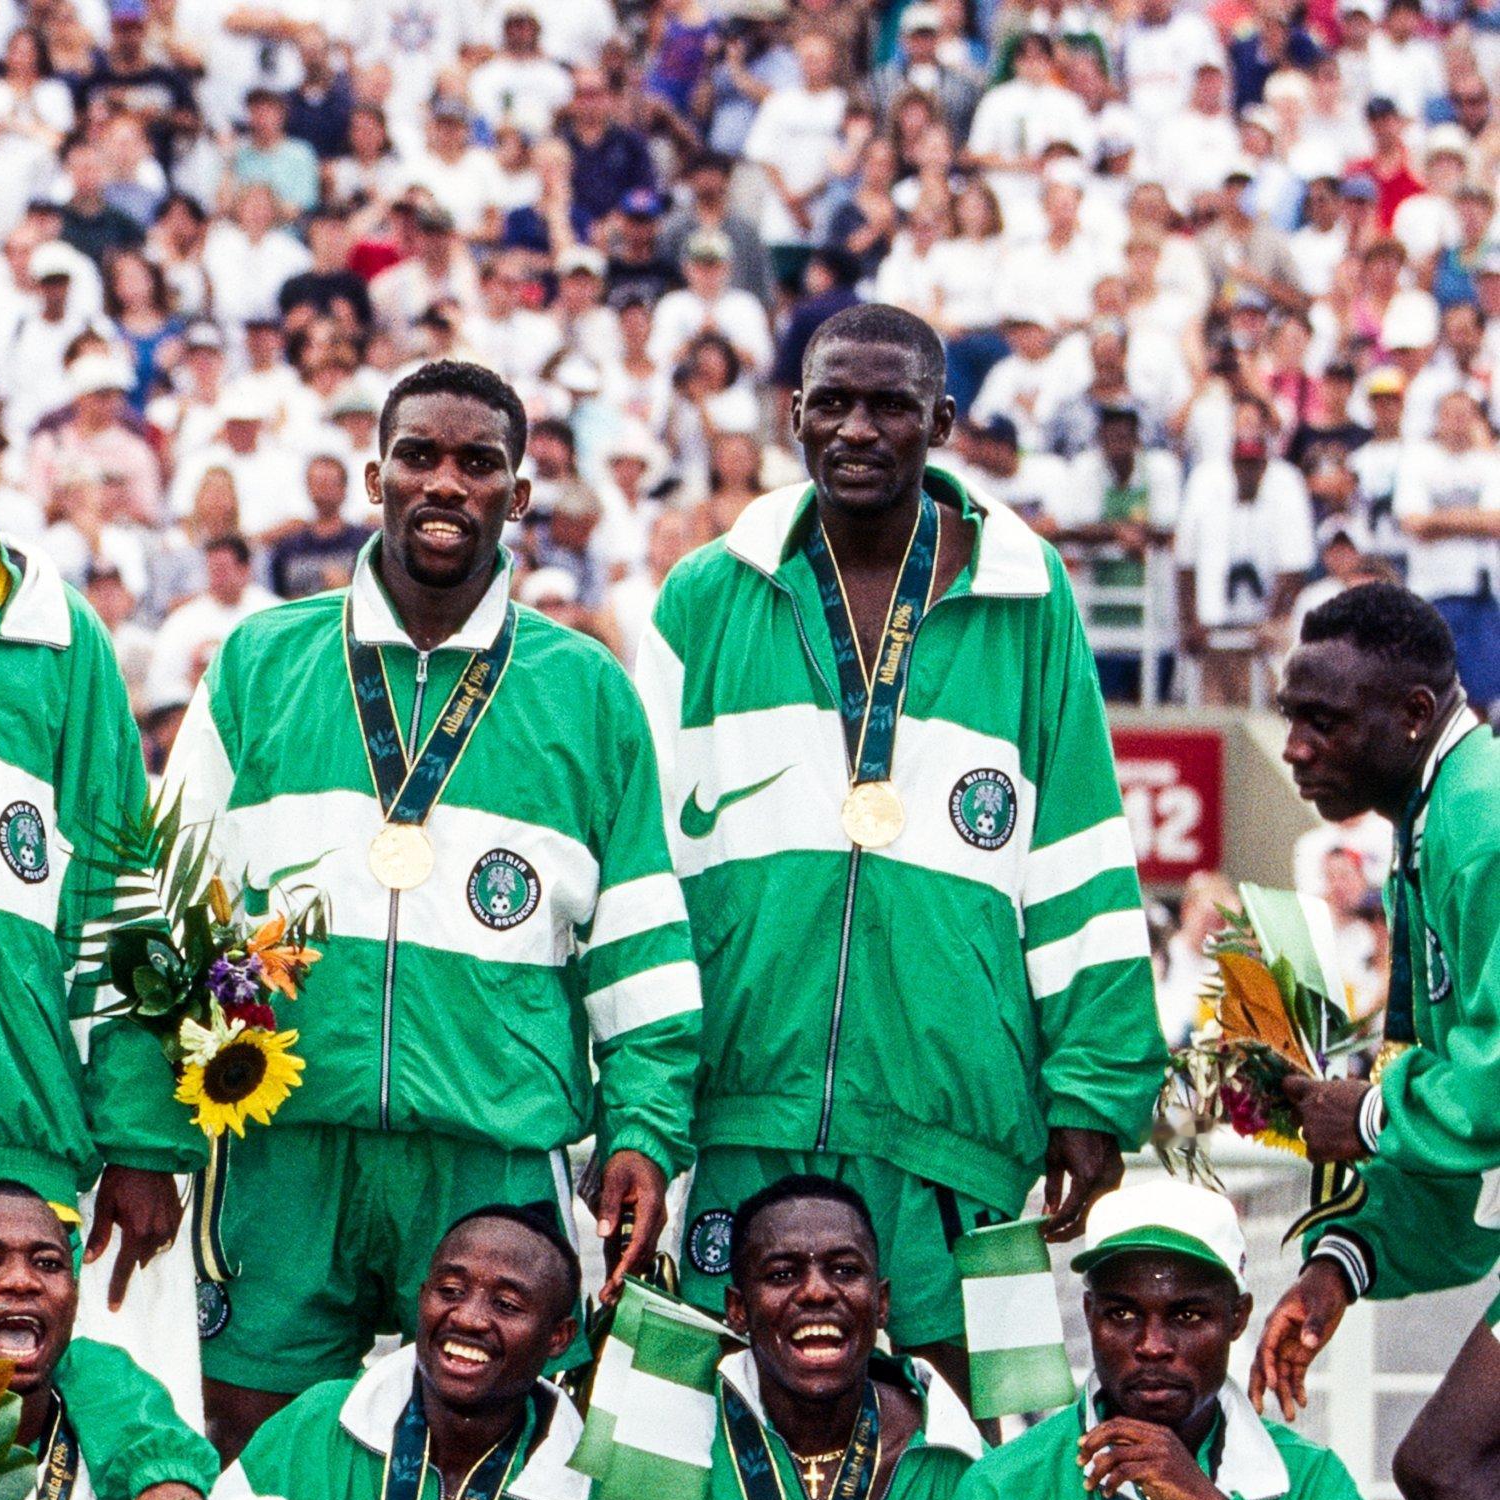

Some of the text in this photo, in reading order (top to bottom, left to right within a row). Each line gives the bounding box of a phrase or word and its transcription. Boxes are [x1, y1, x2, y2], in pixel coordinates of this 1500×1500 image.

[878, 604, 913, 685] Atlanta 1996
[441, 662, 491, 737] Atlanta 1996
[964, 770, 1013, 794] NIGERIA
[952, 789, 976, 843] FOOTBALL
[1122, 783, 1203, 863] 12
[480, 852, 528, 873] NIGERIA
[494, 877, 538, 926] ASSOCIATION
